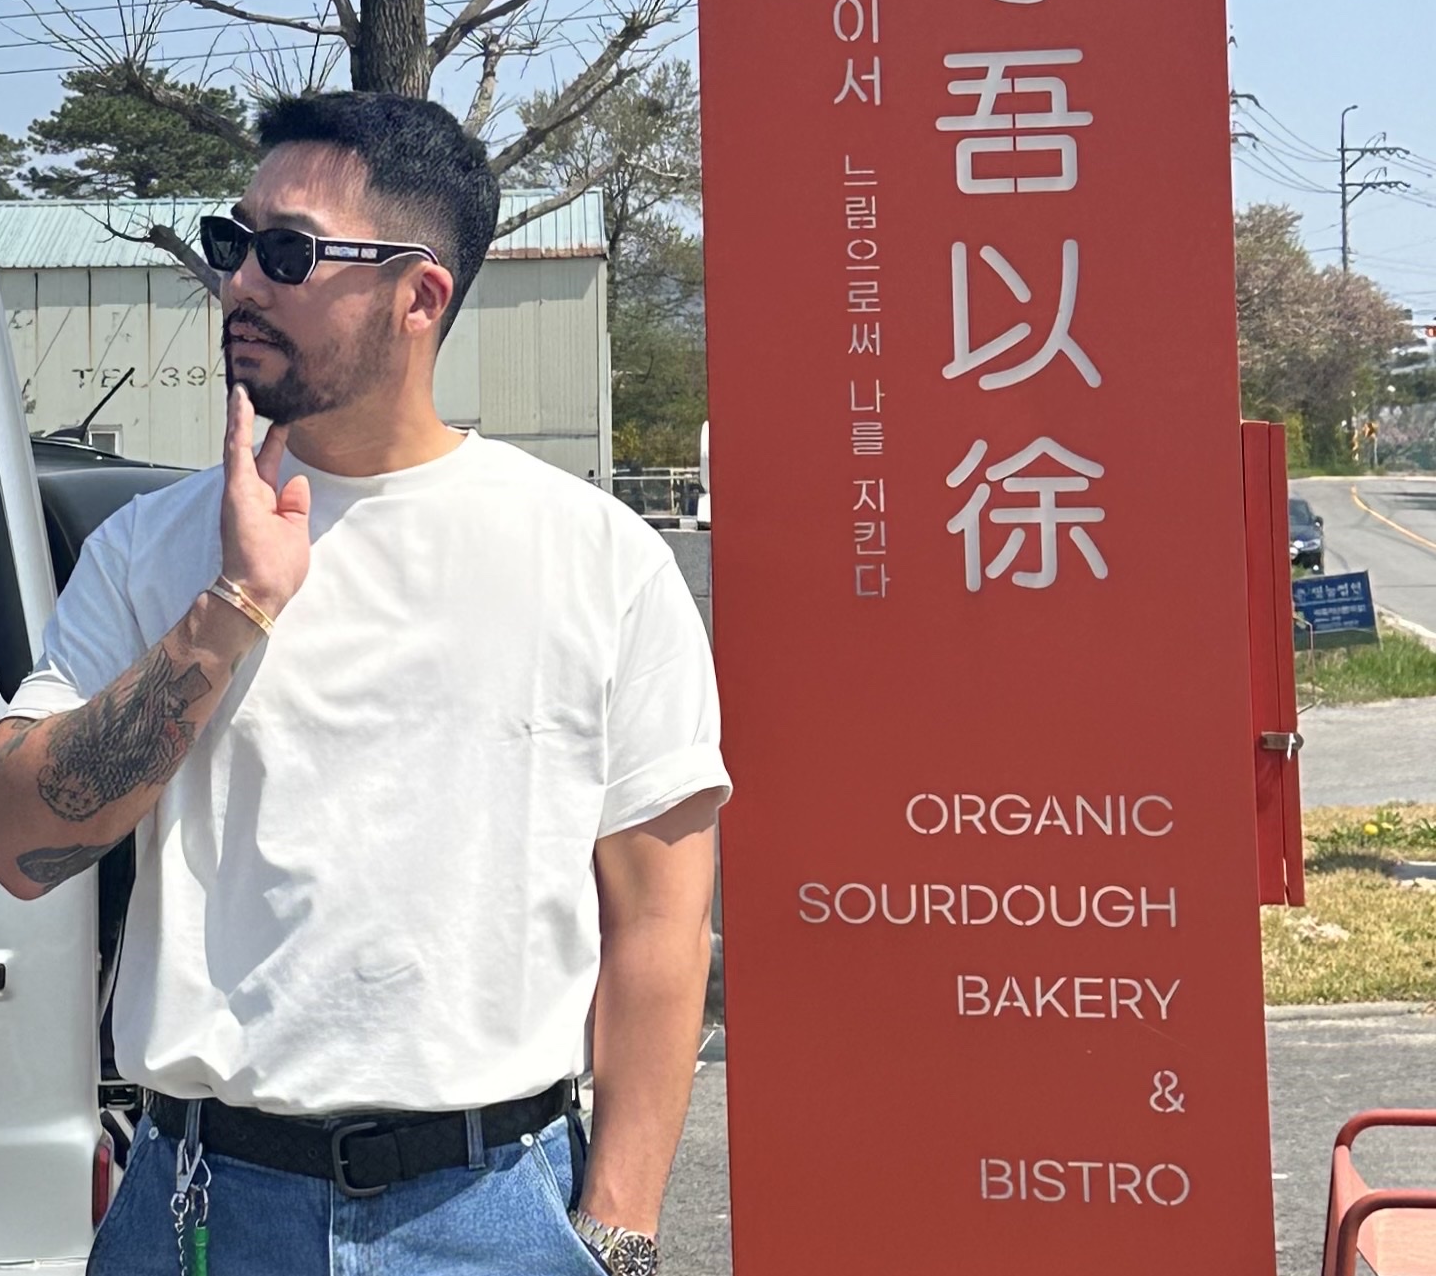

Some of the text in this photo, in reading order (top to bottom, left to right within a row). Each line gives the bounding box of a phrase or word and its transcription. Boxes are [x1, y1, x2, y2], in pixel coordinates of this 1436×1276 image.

[843, 154, 882, 357] 느림으로써
[850, 378, 886, 456] 나를
[852, 477, 891, 599] 지킨다
[905, 793, 1174, 837] ORGANIC
[799, 882, 1177, 928] SOURDOUGH
[956, 974, 1181, 1021] BAKERY
[1149, 1069, 1186, 1114] &
[980, 1158, 1191, 1207] BISTRO
